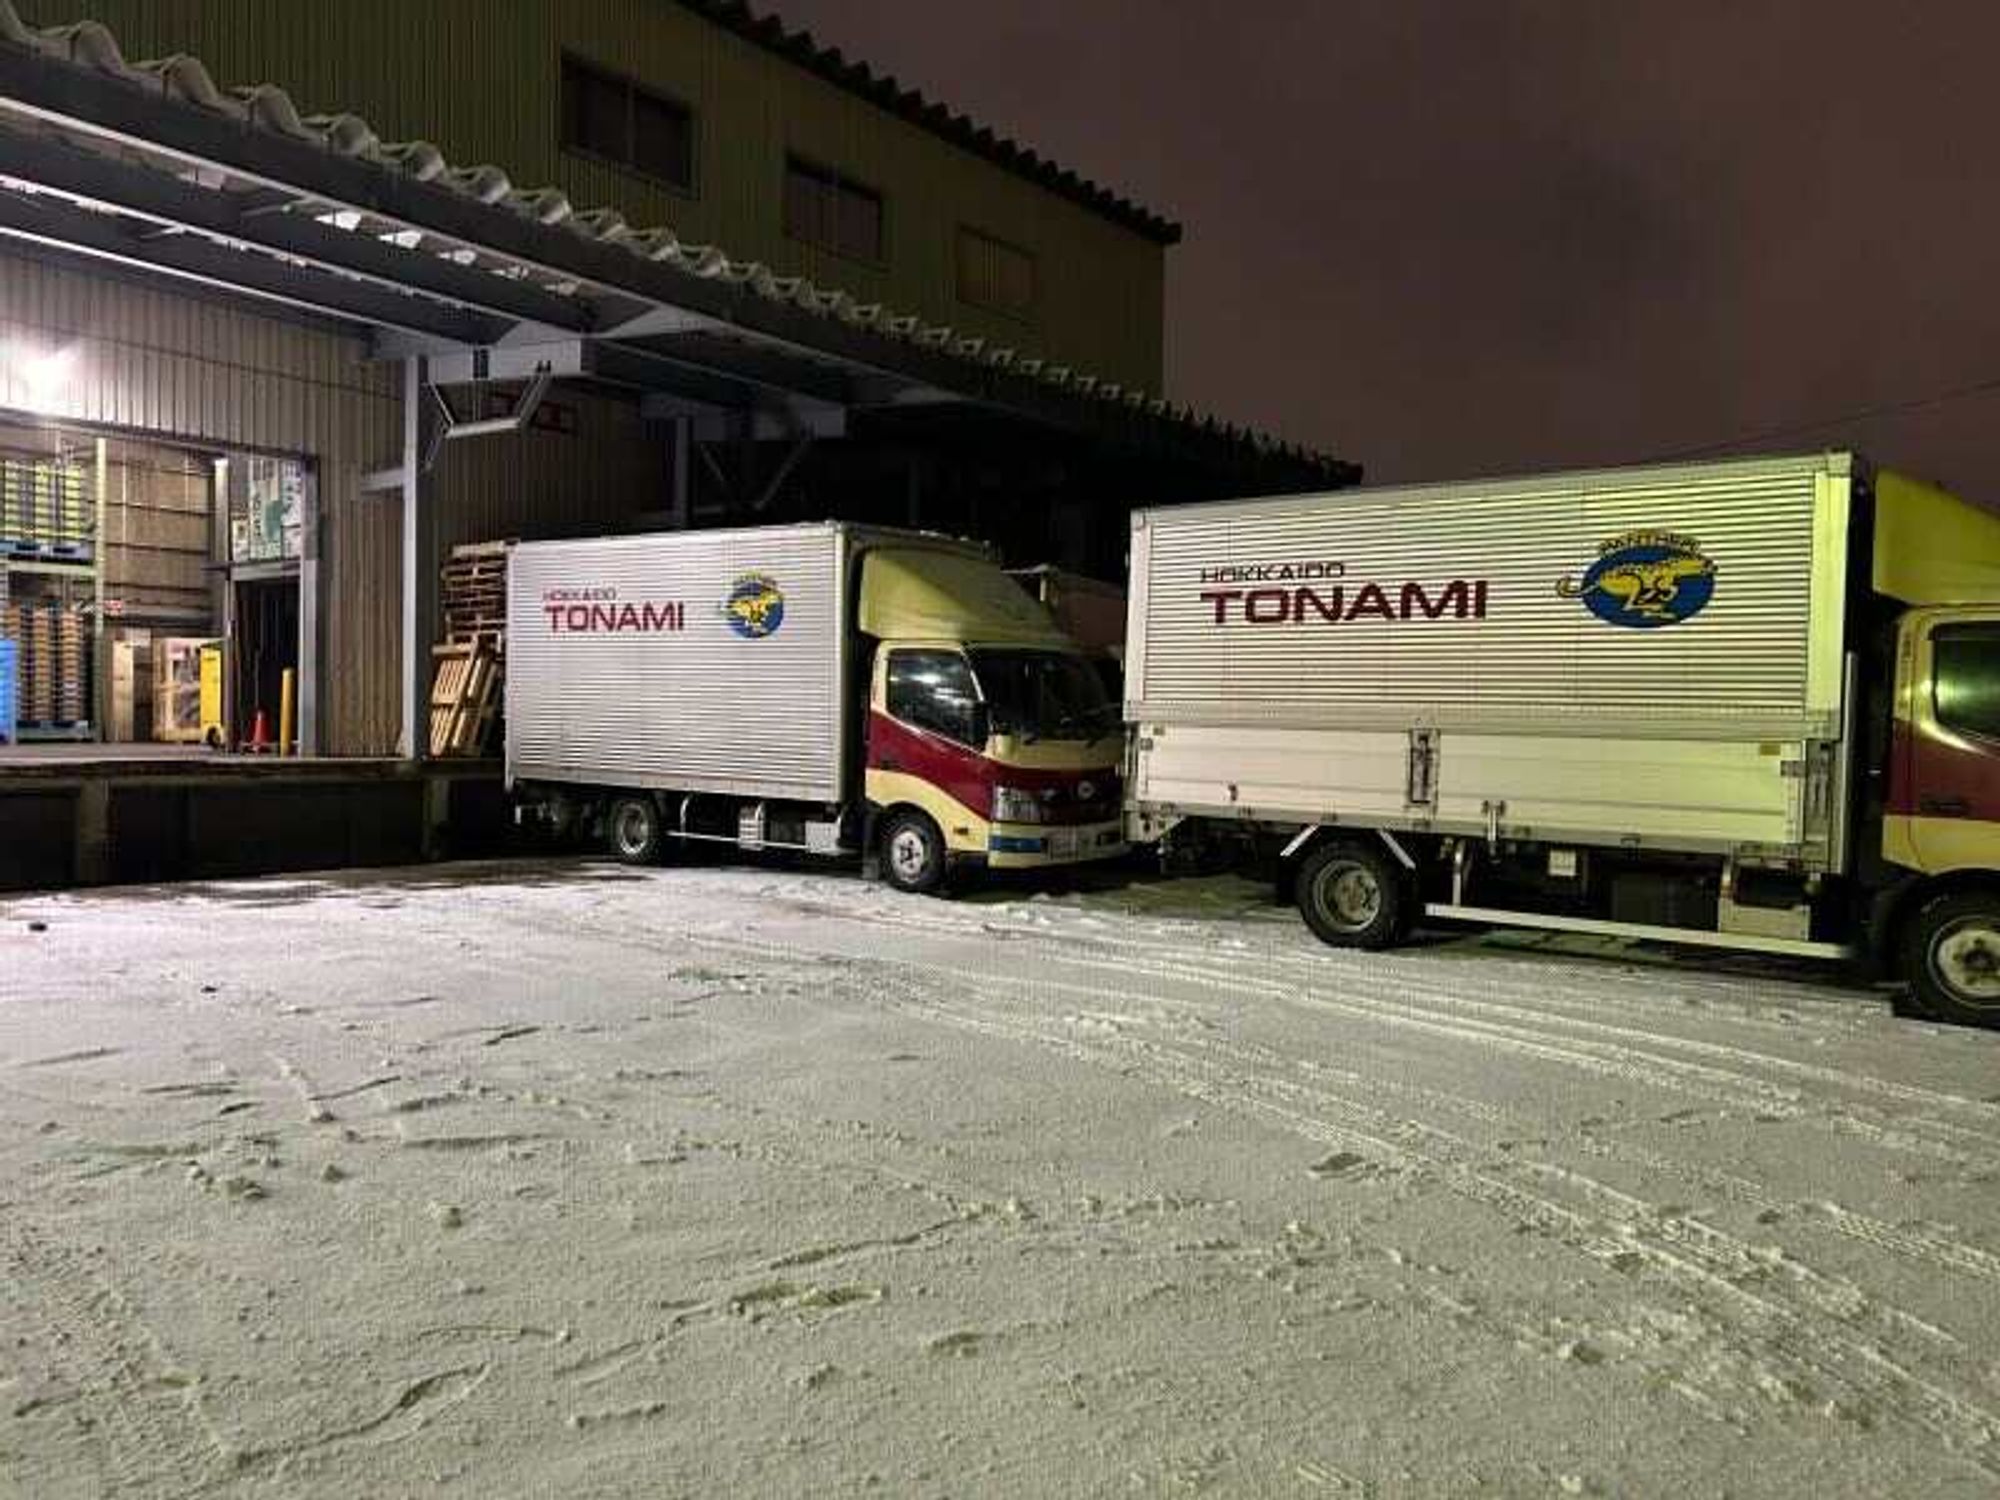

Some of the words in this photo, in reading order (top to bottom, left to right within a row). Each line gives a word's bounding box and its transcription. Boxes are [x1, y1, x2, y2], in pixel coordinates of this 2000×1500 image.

[1201, 562, 1345, 583] HOKKAIDO
[544, 601, 684, 632] TONAMI
[1201, 581, 1488, 624] TONAMI
